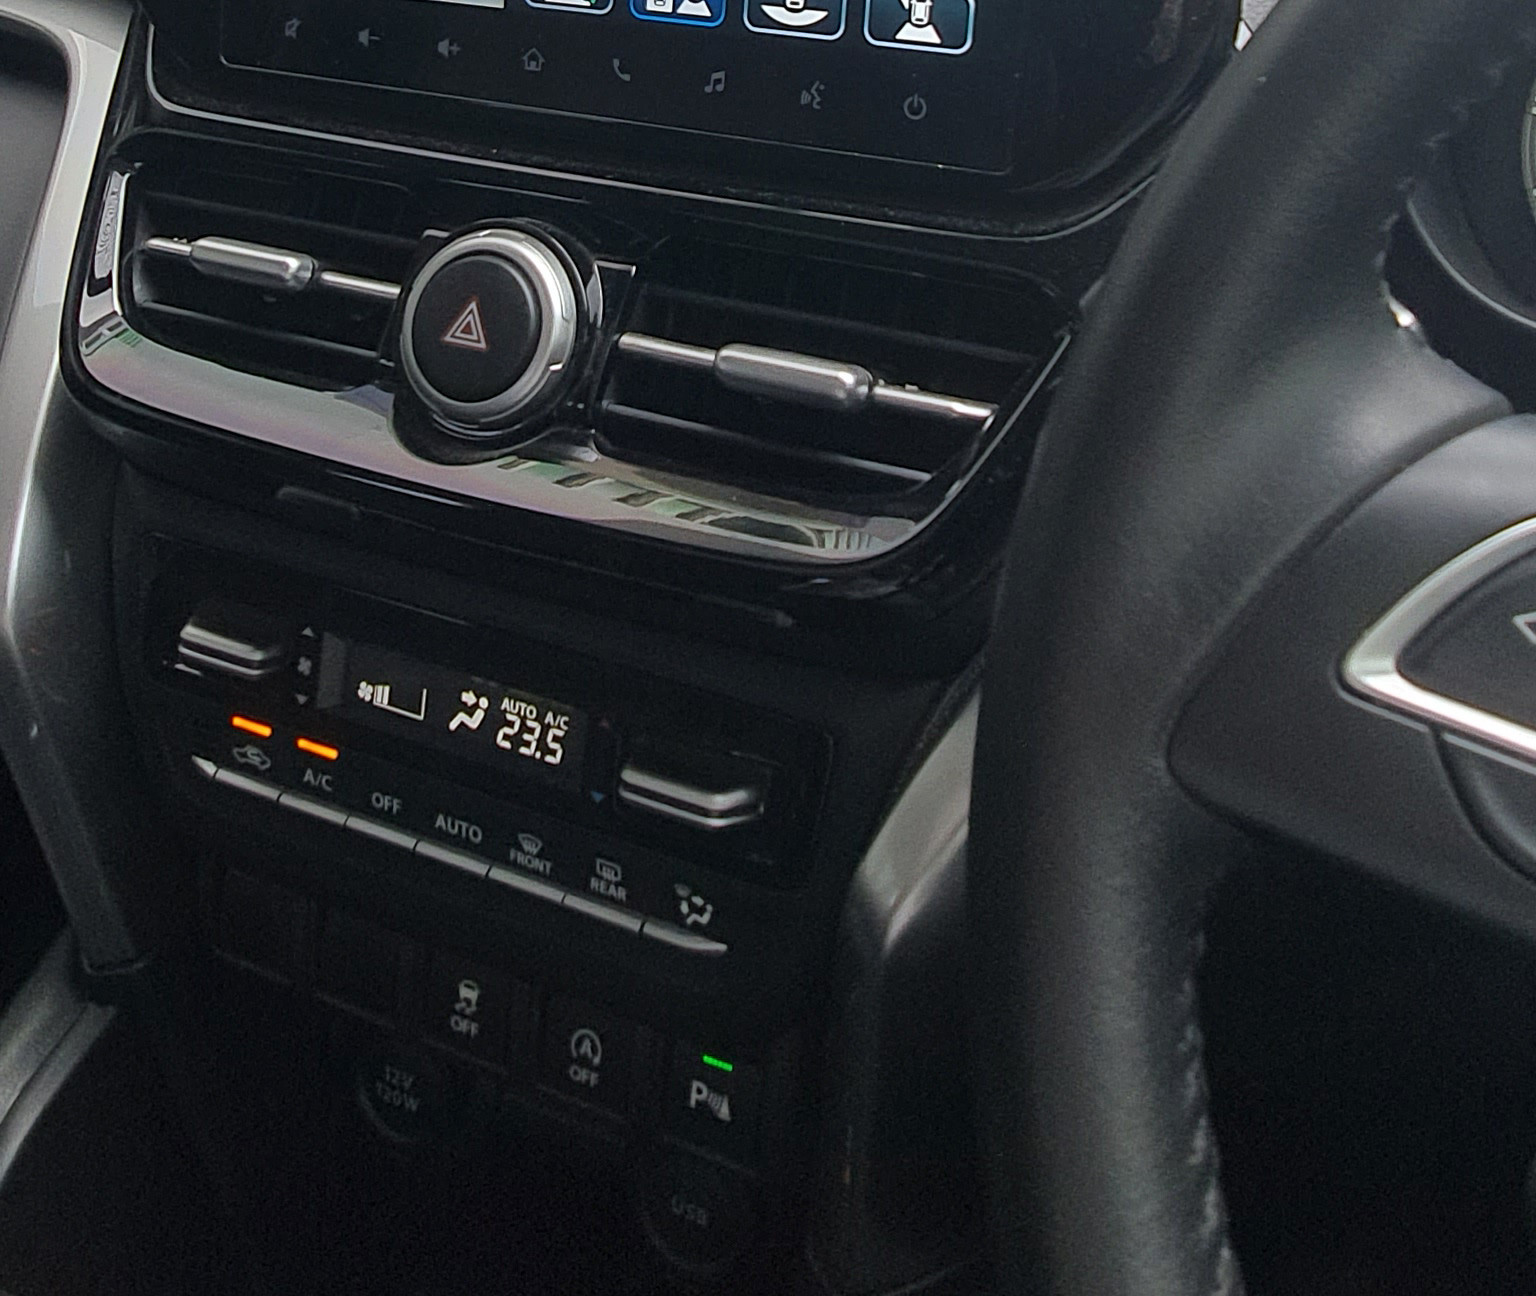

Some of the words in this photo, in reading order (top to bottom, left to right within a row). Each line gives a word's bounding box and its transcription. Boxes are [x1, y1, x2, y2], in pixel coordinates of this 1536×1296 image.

[501, 697, 537, 720] AUTO
[545, 710, 569, 731] A/C
[497, 715, 565, 765] 23.5
[303, 769, 333, 791] A/C
[372, 792, 402, 815] OFF
[435, 814, 482, 844] AUTO
[510, 848, 553, 876] FRONT
[591, 877, 626, 902] REAR
[451, 1016, 480, 1037] OFF
[569, 1066, 600, 1087] OFF
